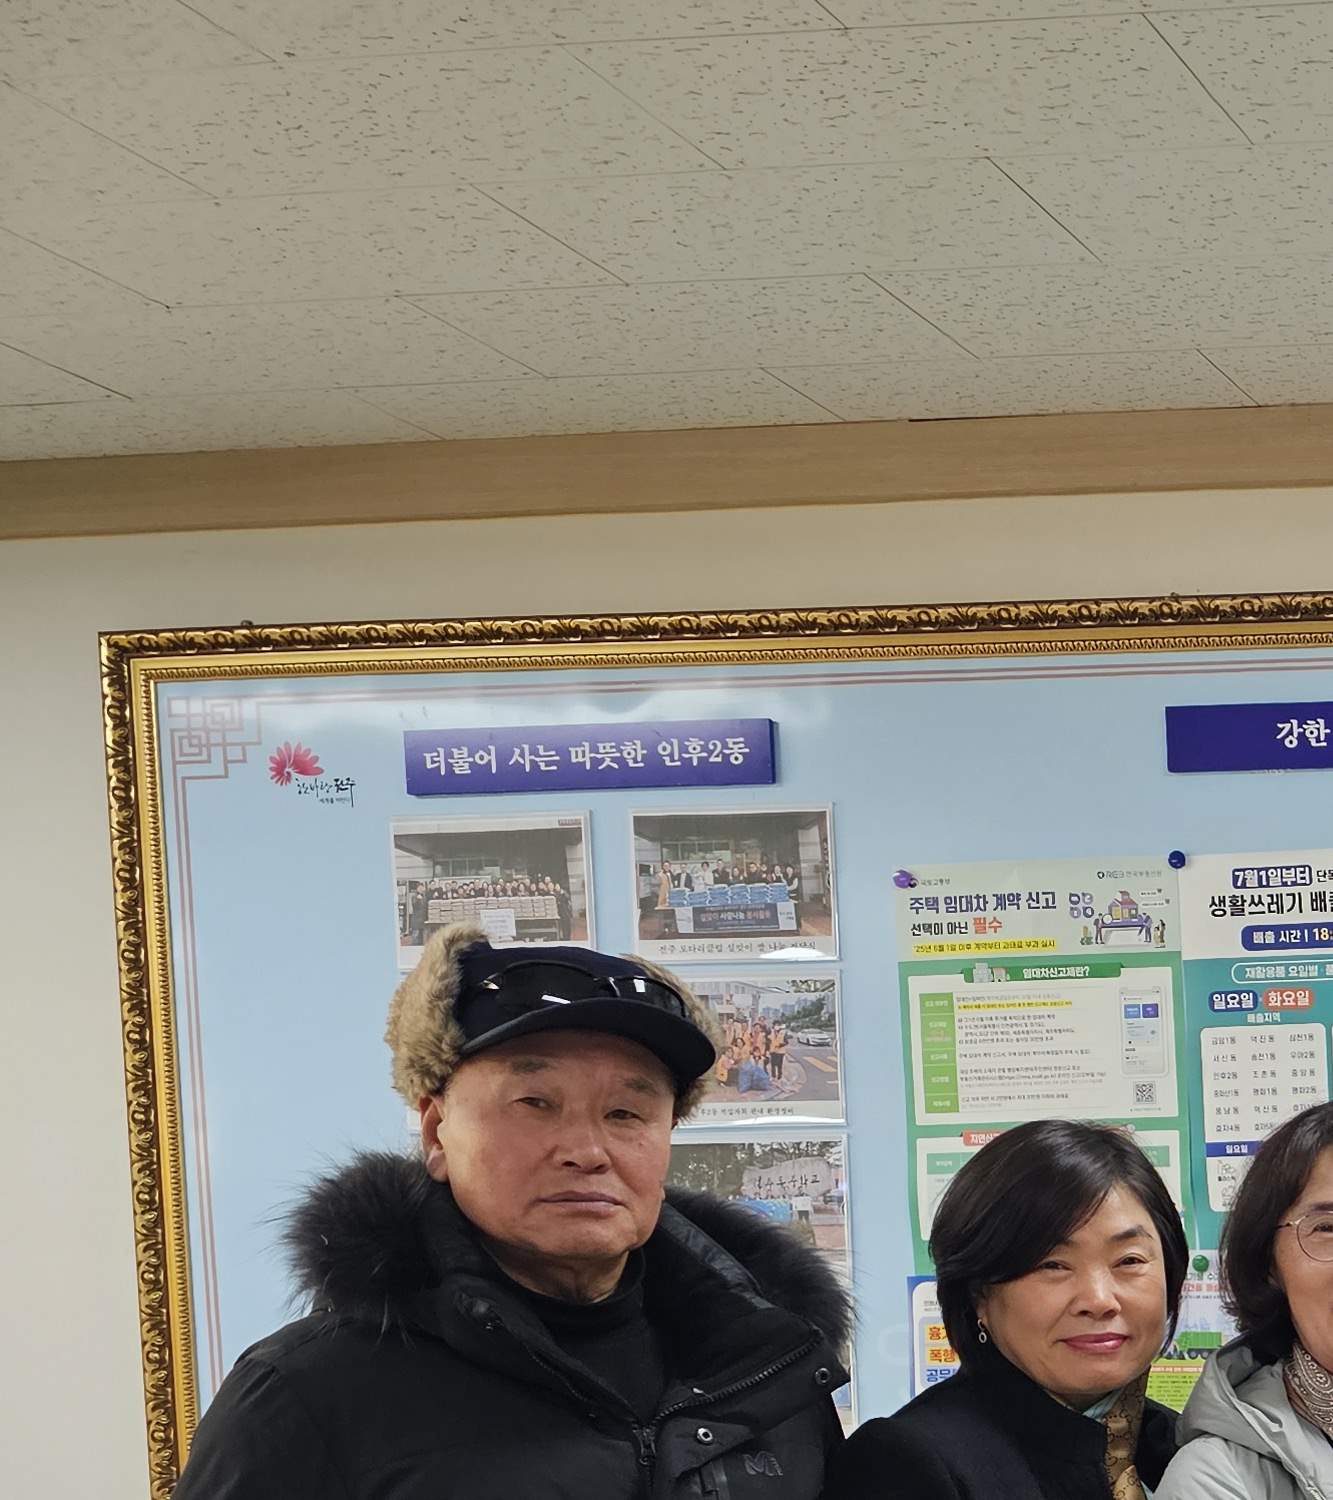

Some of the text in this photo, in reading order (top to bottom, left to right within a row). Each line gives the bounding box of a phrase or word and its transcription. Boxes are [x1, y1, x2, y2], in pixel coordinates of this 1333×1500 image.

[1276, 717, 1331, 749] 강한
[423, 736, 750, 776] 더불어 사는 따뜻한 인후2동
[1105, 870, 1125, 879] REB
[909, 891, 1056, 915] 주택 임대차 계약 신고
[1208, 892, 1303, 918] 생활쓰레기
[911, 916, 1002, 936] 선택이 아닌 필수
[1253, 931, 1275, 944] 배출
[1279, 929, 1302, 943] 시간
[946, 944, 956, 952] 1일
[958, 943, 972, 951] 이후
[973, 941, 1000, 951] 계약부터
[1003, 940, 1023, 949] 과태료
[1025, 940, 1039, 948] 부과
[1041, 939, 1055, 948] 실시
[1022, 967, 1090, 979] 임대차신고제란?
[1245, 965, 1285, 979] 재활용품
[1288, 963, 1318, 977] 요일별
[1211, 987, 1311, 1010] 일요일 화요일
[1247, 1012, 1281, 1024] 배출지역
[929, 1348, 956, 1363] 폭행
